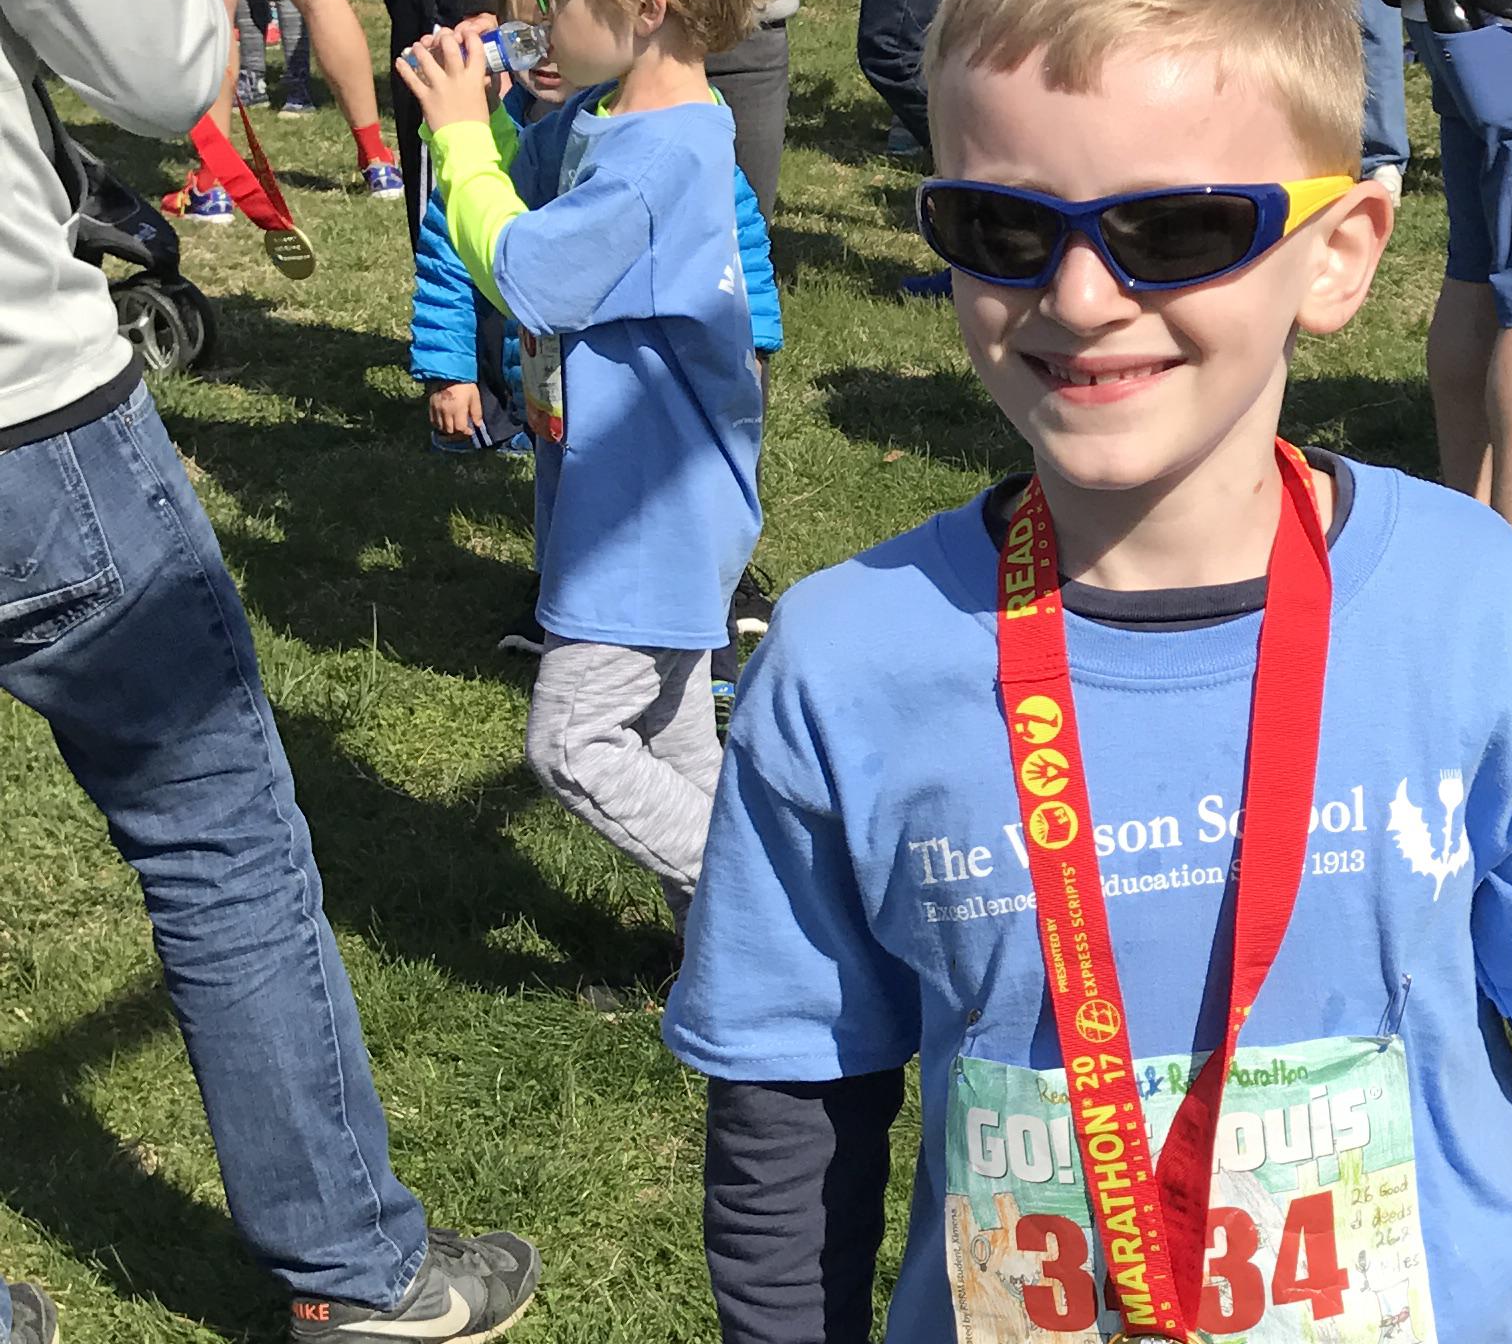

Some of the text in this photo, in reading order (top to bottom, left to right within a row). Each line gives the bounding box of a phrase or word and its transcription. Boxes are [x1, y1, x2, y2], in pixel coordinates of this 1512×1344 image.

[909, 785, 1367, 885] The Wson Scol
[922, 891, 1036, 923] Excellence
[1099, 864, 1224, 898] ducation
[1311, 849, 1365, 875] 1913
[1046, 917, 1069, 993] PRESENTED BY
[1063, 866, 1098, 997] EXPRESS SCRIPTS
[1071, 1055, 1099, 1091] 20
[1100, 1053, 1126, 1084] 17
[967, 1086, 1372, 1185] GO! ouis
[1123, 1102, 1148, 1183] MILES
[1082, 1104, 1157, 1326] MARATHON
[1351, 1174, 1409, 1206] 26 Good
[1016, 1190, 1351, 1336] 334
